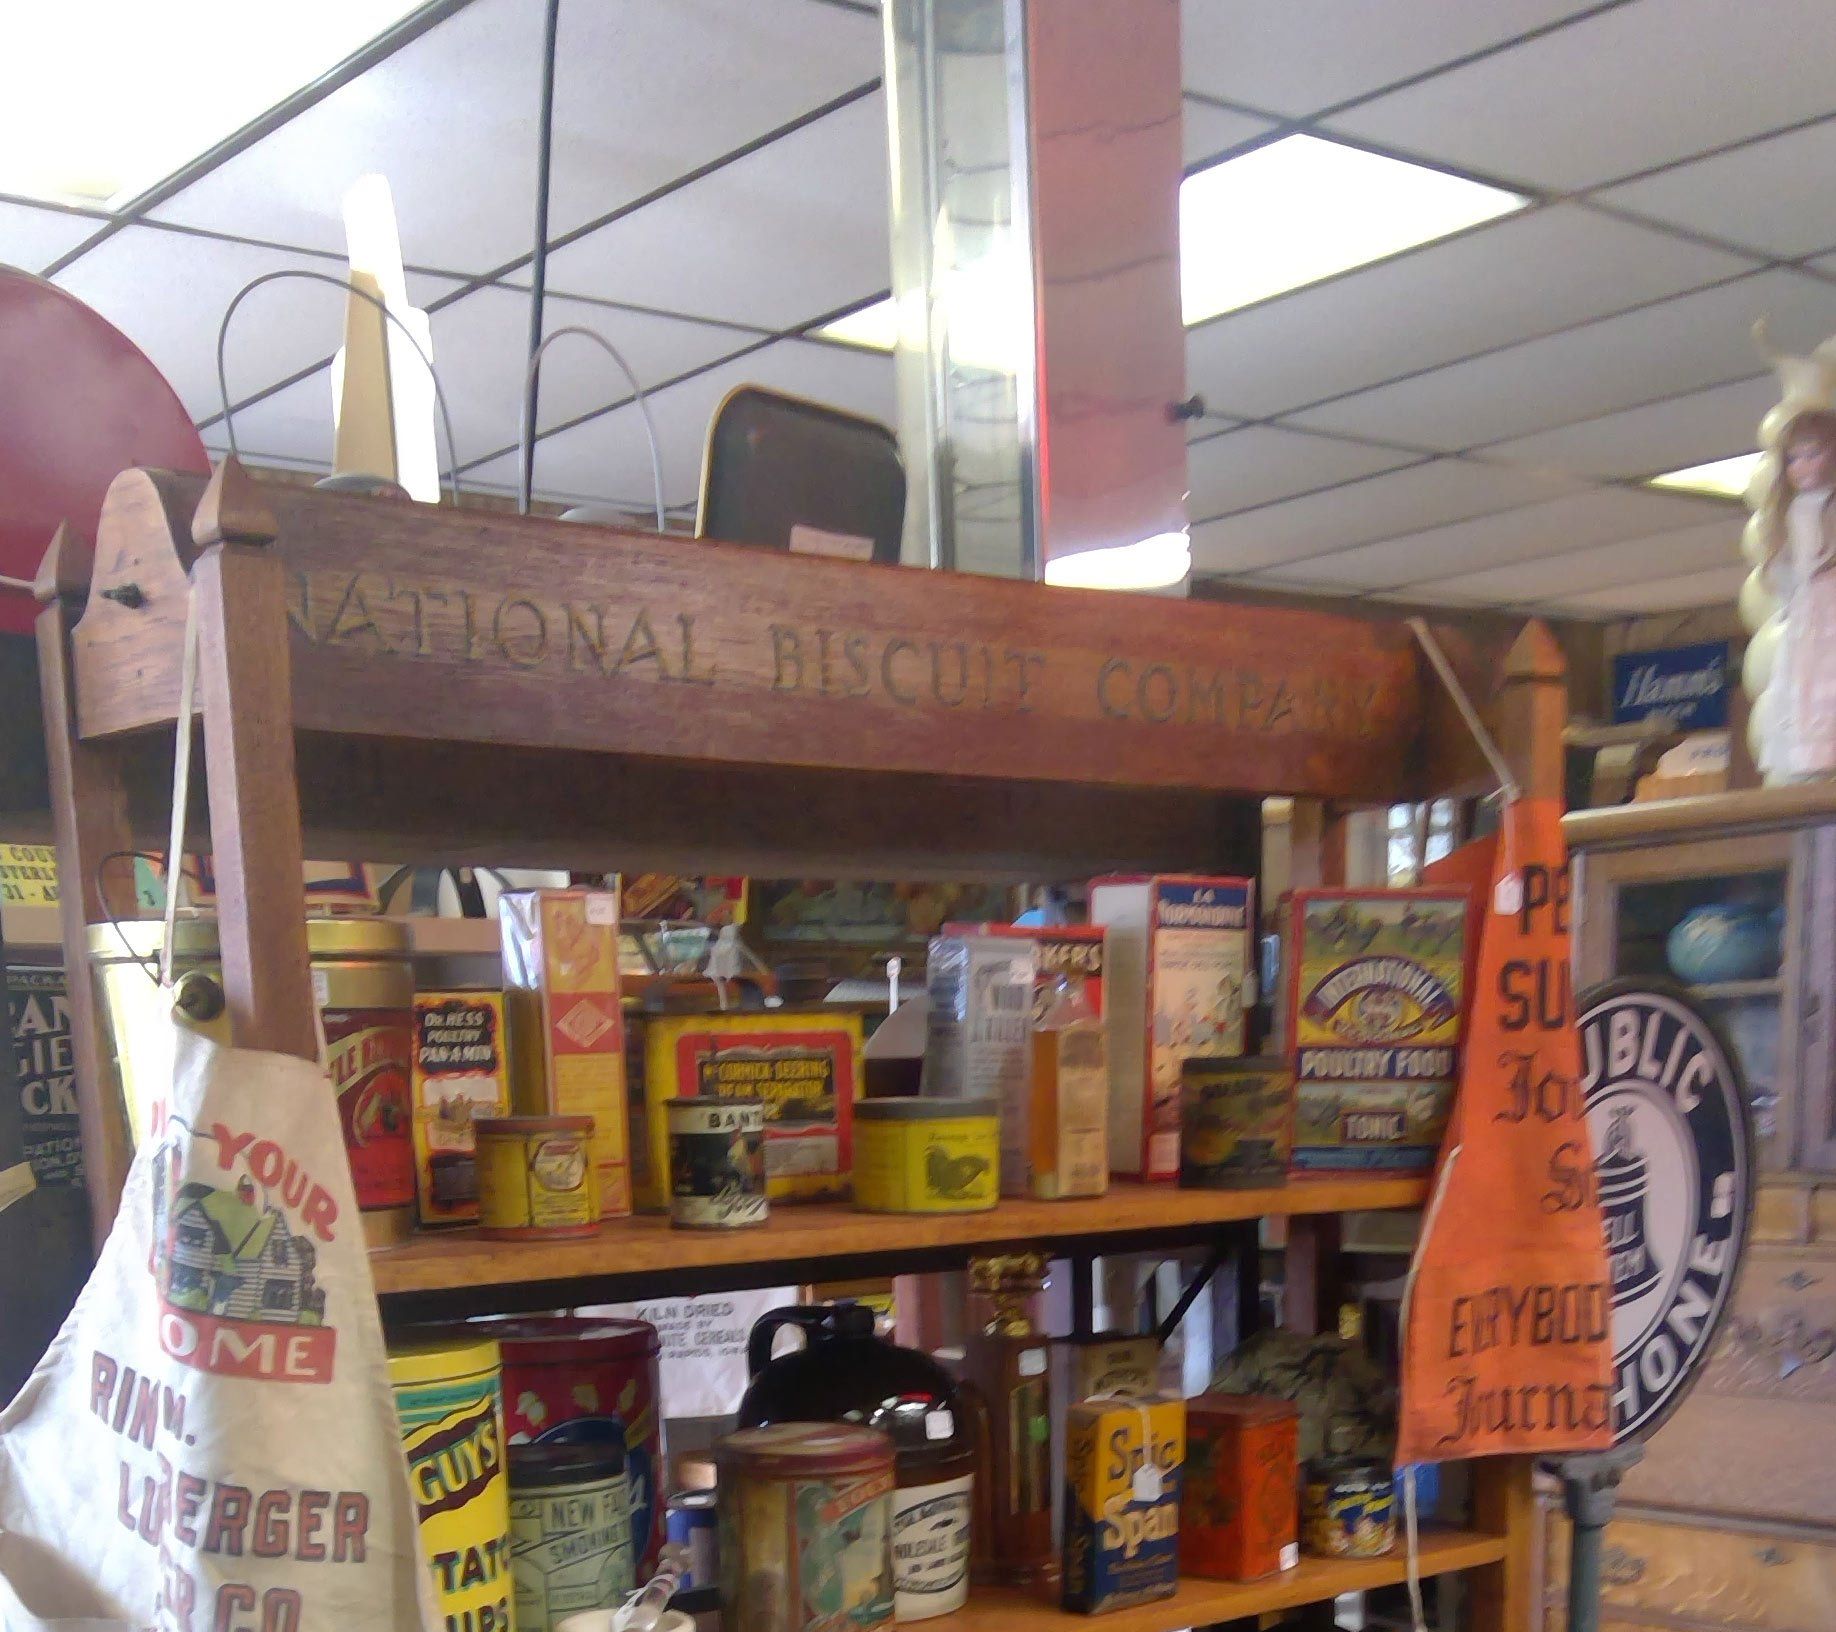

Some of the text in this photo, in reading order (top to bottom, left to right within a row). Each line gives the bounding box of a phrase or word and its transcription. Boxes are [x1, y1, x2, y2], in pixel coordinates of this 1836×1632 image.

[768, 622, 1047, 714] BISCUIT
[1097, 655, 1382, 738] COMPANY
[426, 1027, 483, 1044] POULTRY
[1301, 1048, 1453, 1077] POULTRY FOOD
[211, 1121, 339, 1242] YOUR
[683, 1301, 735, 1319] DRIED
[161, 1313, 320, 1376] OME
[550, 1499, 595, 1529] NEW
[1103, 1489, 1179, 1559] Span
[433, 1539, 509, 1596] TAT
